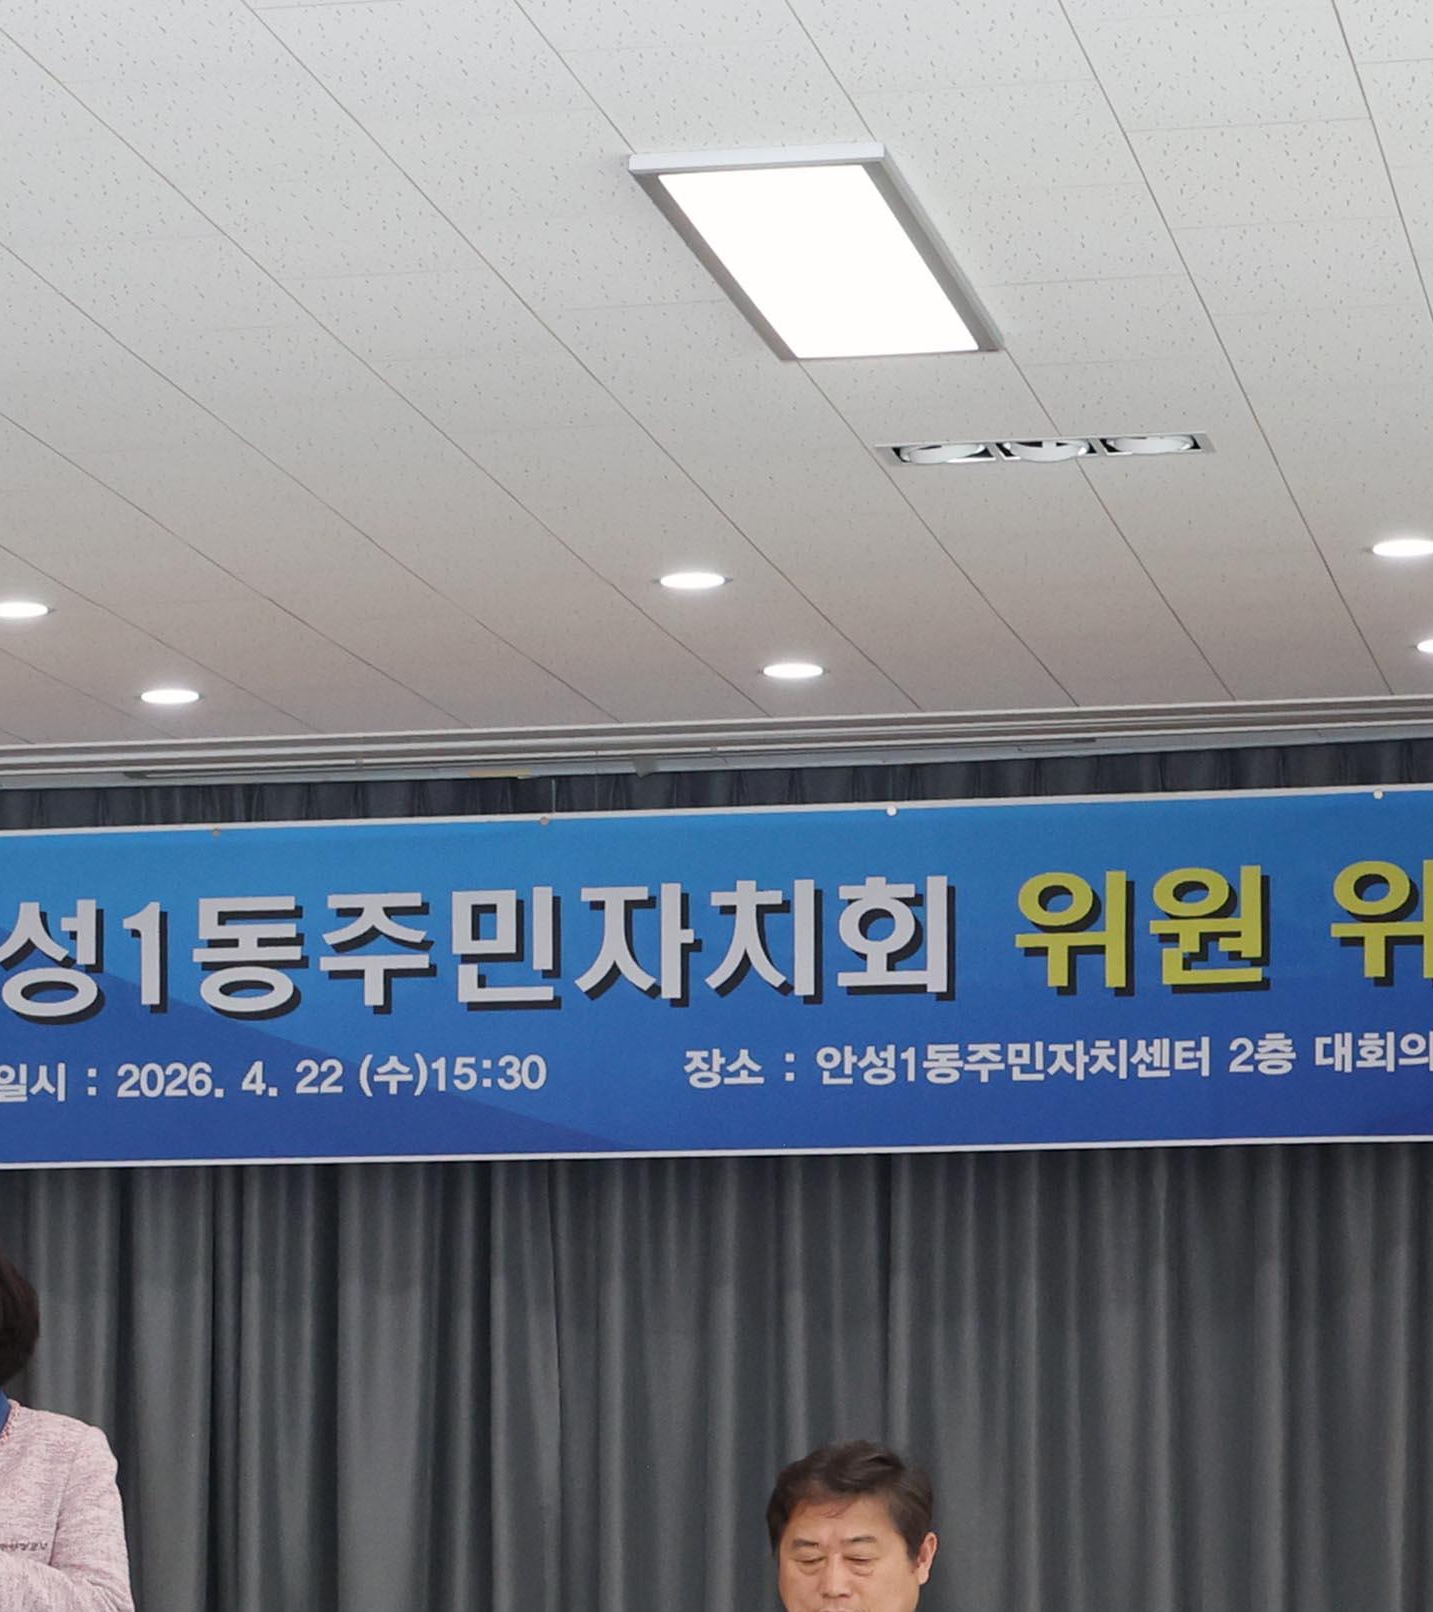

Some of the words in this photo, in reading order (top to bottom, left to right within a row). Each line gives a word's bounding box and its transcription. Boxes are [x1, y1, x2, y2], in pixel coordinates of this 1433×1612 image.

[1014, 864, 1267, 990] 위원
[116, 1061, 225, 1099] 2026.
[240, 1060, 279, 1098] 4.
[295, 1058, 345, 1096] 22
[358, 1051, 548, 1097] (수)15:30
[683, 1047, 765, 1088] 장소
[815, 1034, 1212, 1086] 안성1동주민자치센터
[1229, 1032, 1297, 1076] 2층
